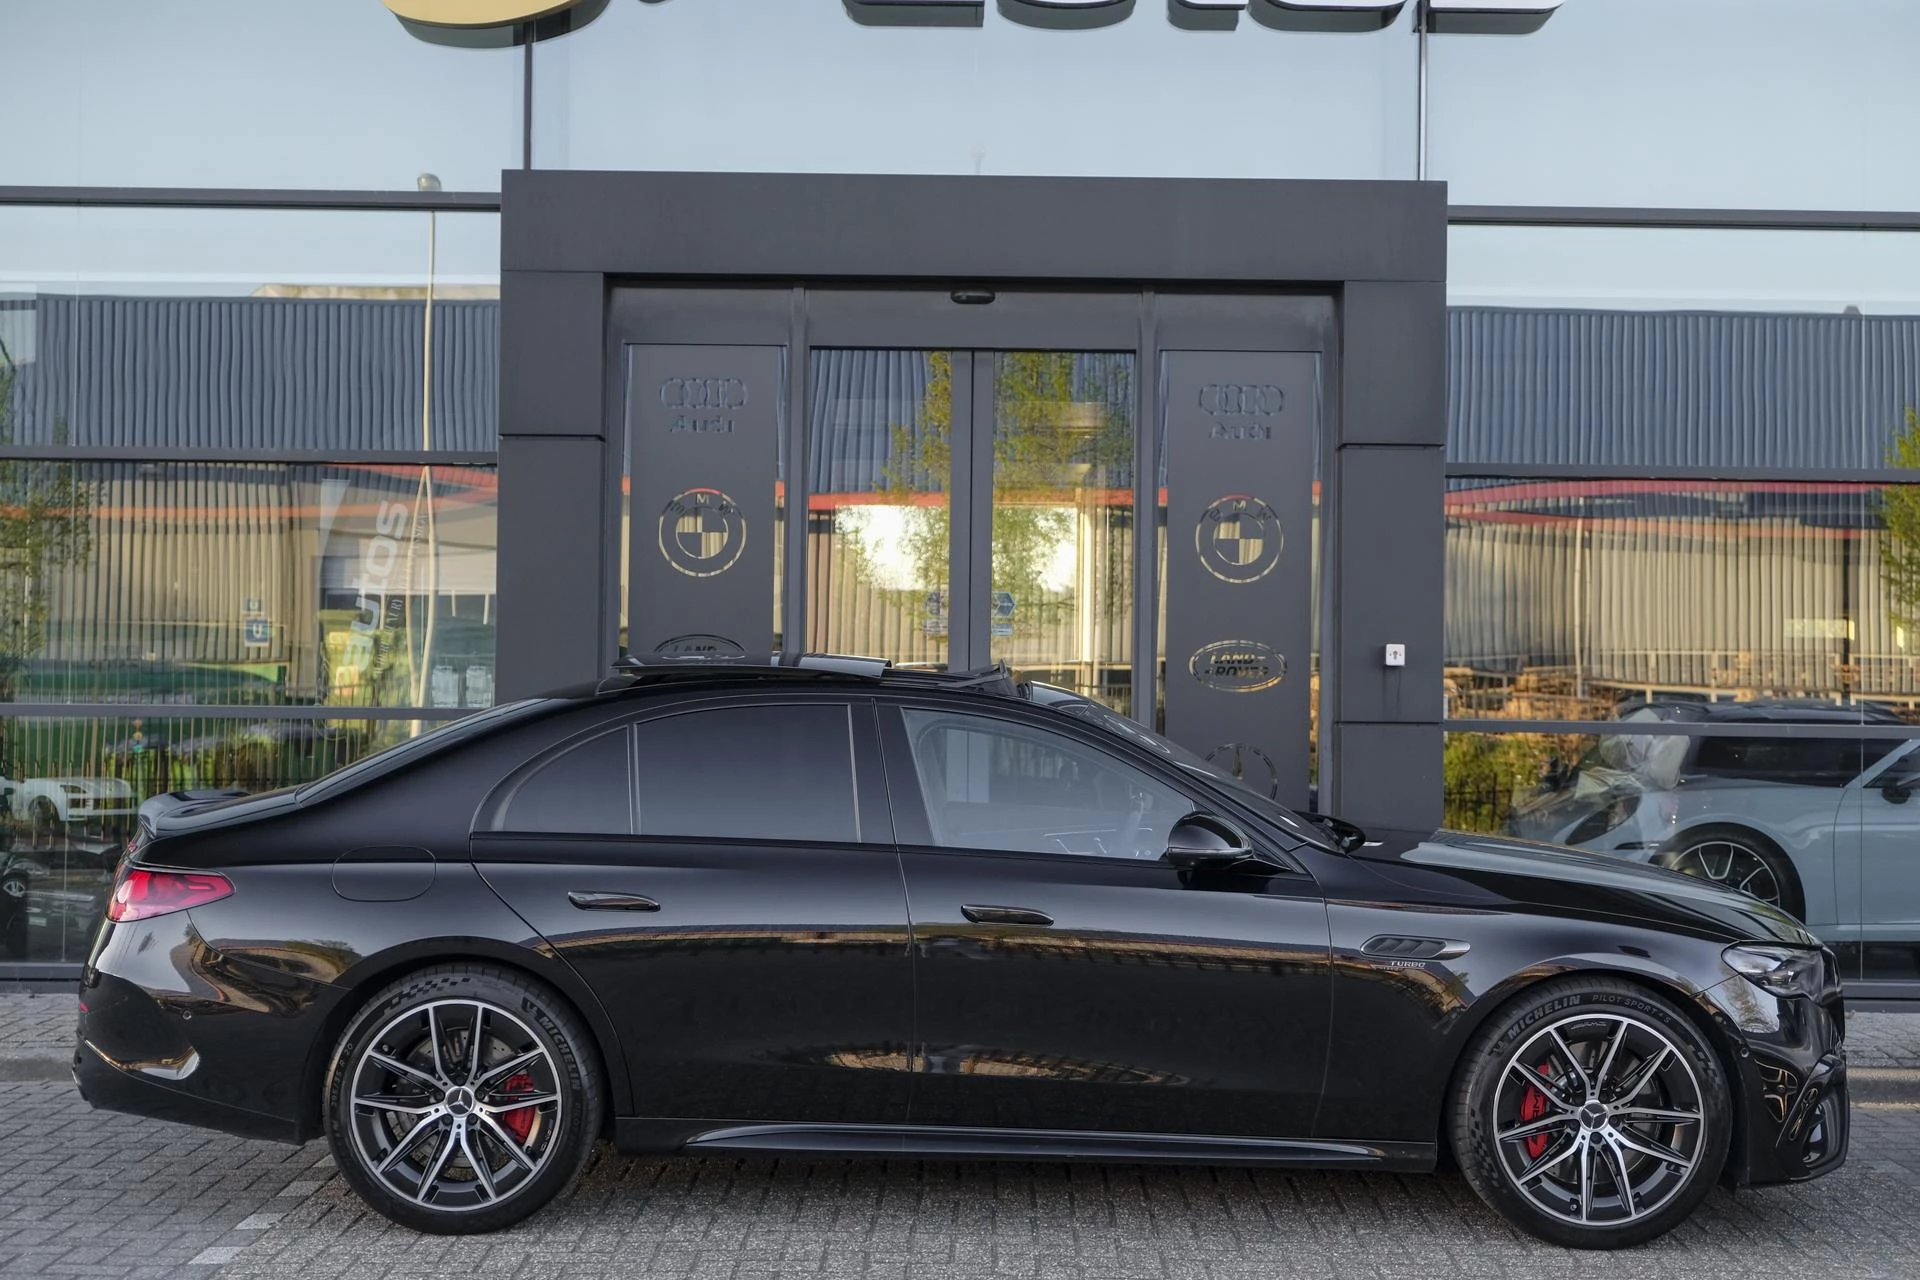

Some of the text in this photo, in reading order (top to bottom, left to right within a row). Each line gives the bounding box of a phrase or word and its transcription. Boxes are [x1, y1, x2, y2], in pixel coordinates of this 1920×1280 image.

[669, 415, 735, 433] Audi
[1208, 421, 1272, 440] Audi
[1210, 653, 1256, 664] LAND
[1390, 960, 1426, 968] TURBO
[1507, 994, 1581, 1040] MICHELIN
[1592, 994, 1623, 1003] PILOT
[1624, 999, 1657, 1015] SPORT
[344, 1042, 354, 1057] 20
[537, 1015, 582, 1091] MICHELIN
